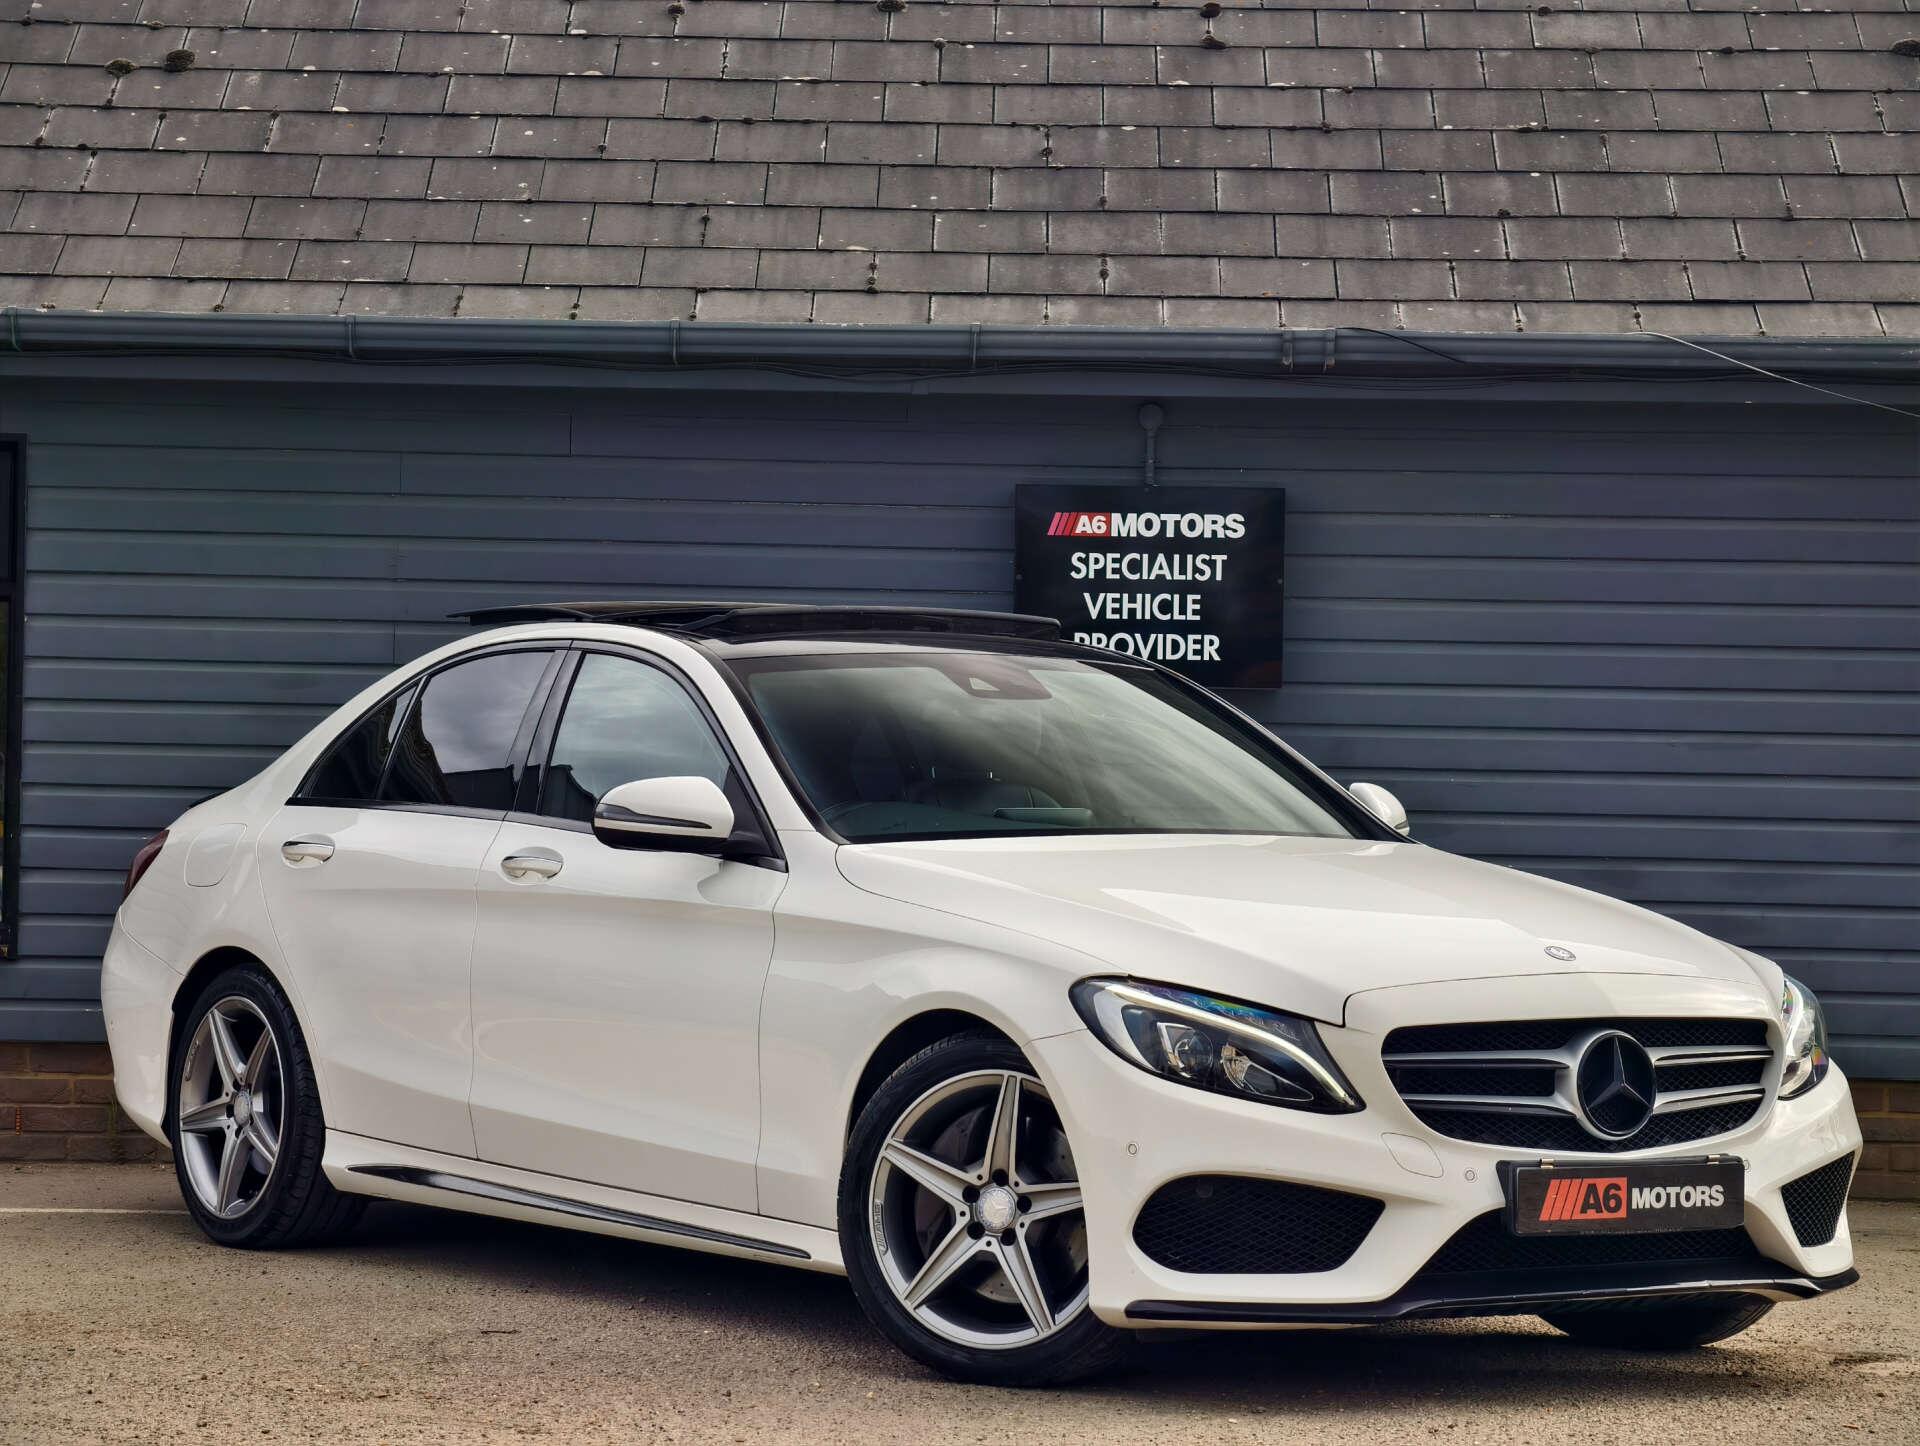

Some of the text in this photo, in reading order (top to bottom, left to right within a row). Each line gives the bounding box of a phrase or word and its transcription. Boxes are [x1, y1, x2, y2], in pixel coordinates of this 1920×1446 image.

[1075, 512, 1246, 539] A6 MOTORS
[1070, 552, 1228, 581] SPECIALIST
[1083, 592, 1201, 621] VEHICLE
[1580, 1183, 1725, 1214] A6 MOTORS
